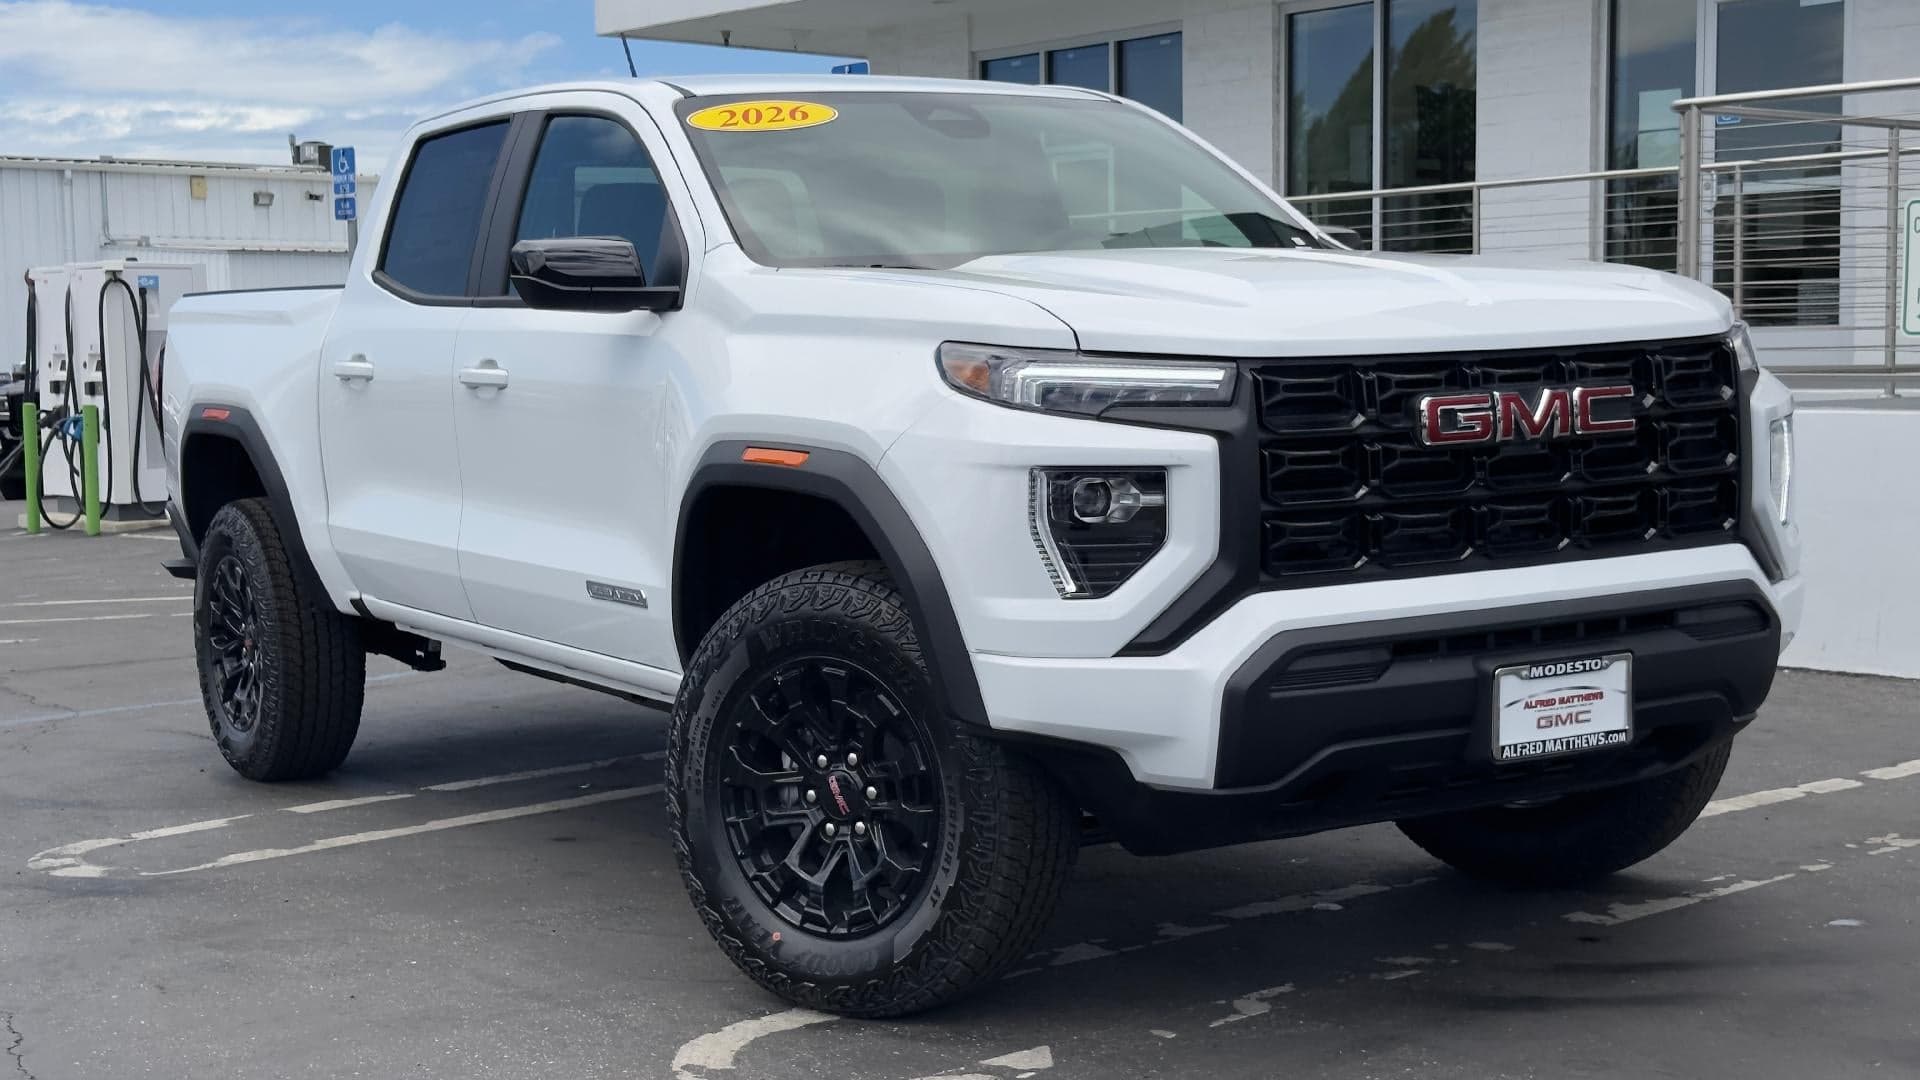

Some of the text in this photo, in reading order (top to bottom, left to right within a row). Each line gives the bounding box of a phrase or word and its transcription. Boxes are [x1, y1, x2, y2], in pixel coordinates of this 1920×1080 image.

[719, 105, 809, 127] 2026
[1420, 385, 1636, 445] GMC
[1530, 659, 1601, 678] MODESTO
[1523, 698, 1557, 710] ALFRED
[1558, 691, 1604, 705] MATTHEWS
[1536, 710, 1592, 730] GMC
[1502, 741, 1543, 759] ALFRED
